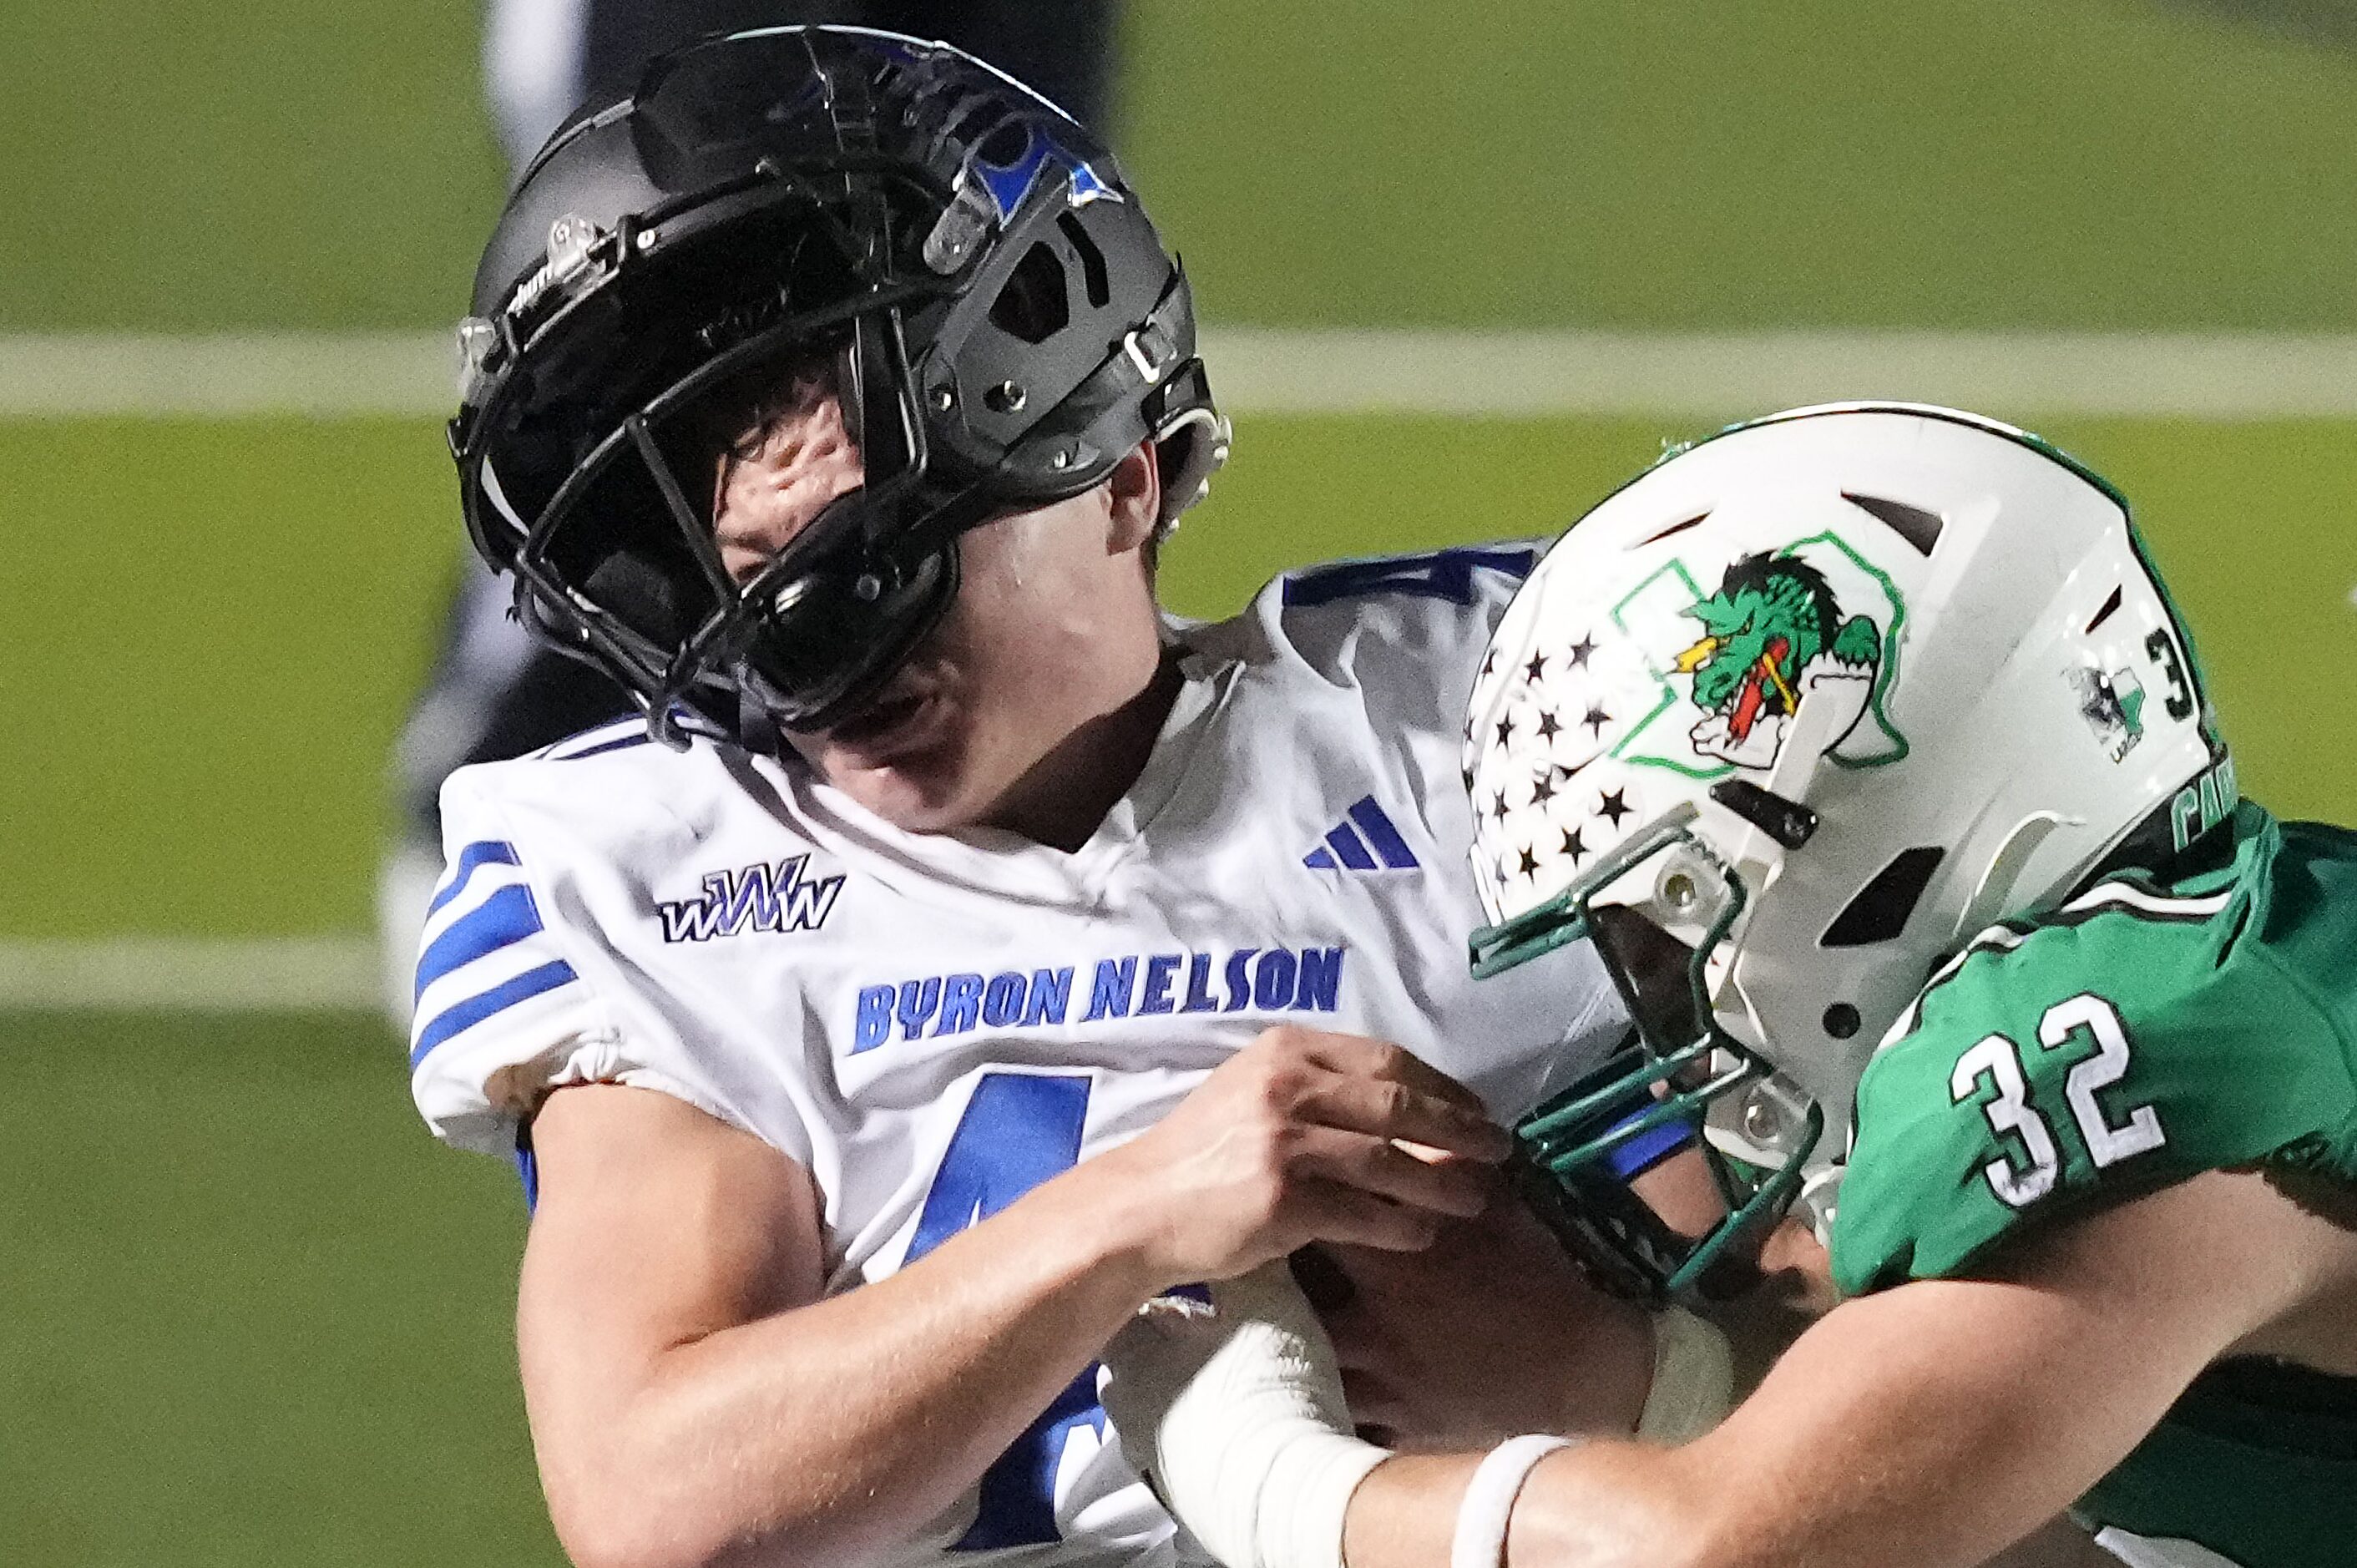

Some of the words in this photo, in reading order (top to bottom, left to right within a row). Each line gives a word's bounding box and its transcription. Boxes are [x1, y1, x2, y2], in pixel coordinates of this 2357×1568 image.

[2144, 627, 2194, 722] 3
[845, 966, 1075, 1055] BYRON
[1079, 947, 1345, 1022] NELSON
[1948, 991, 2167, 1209] 32
